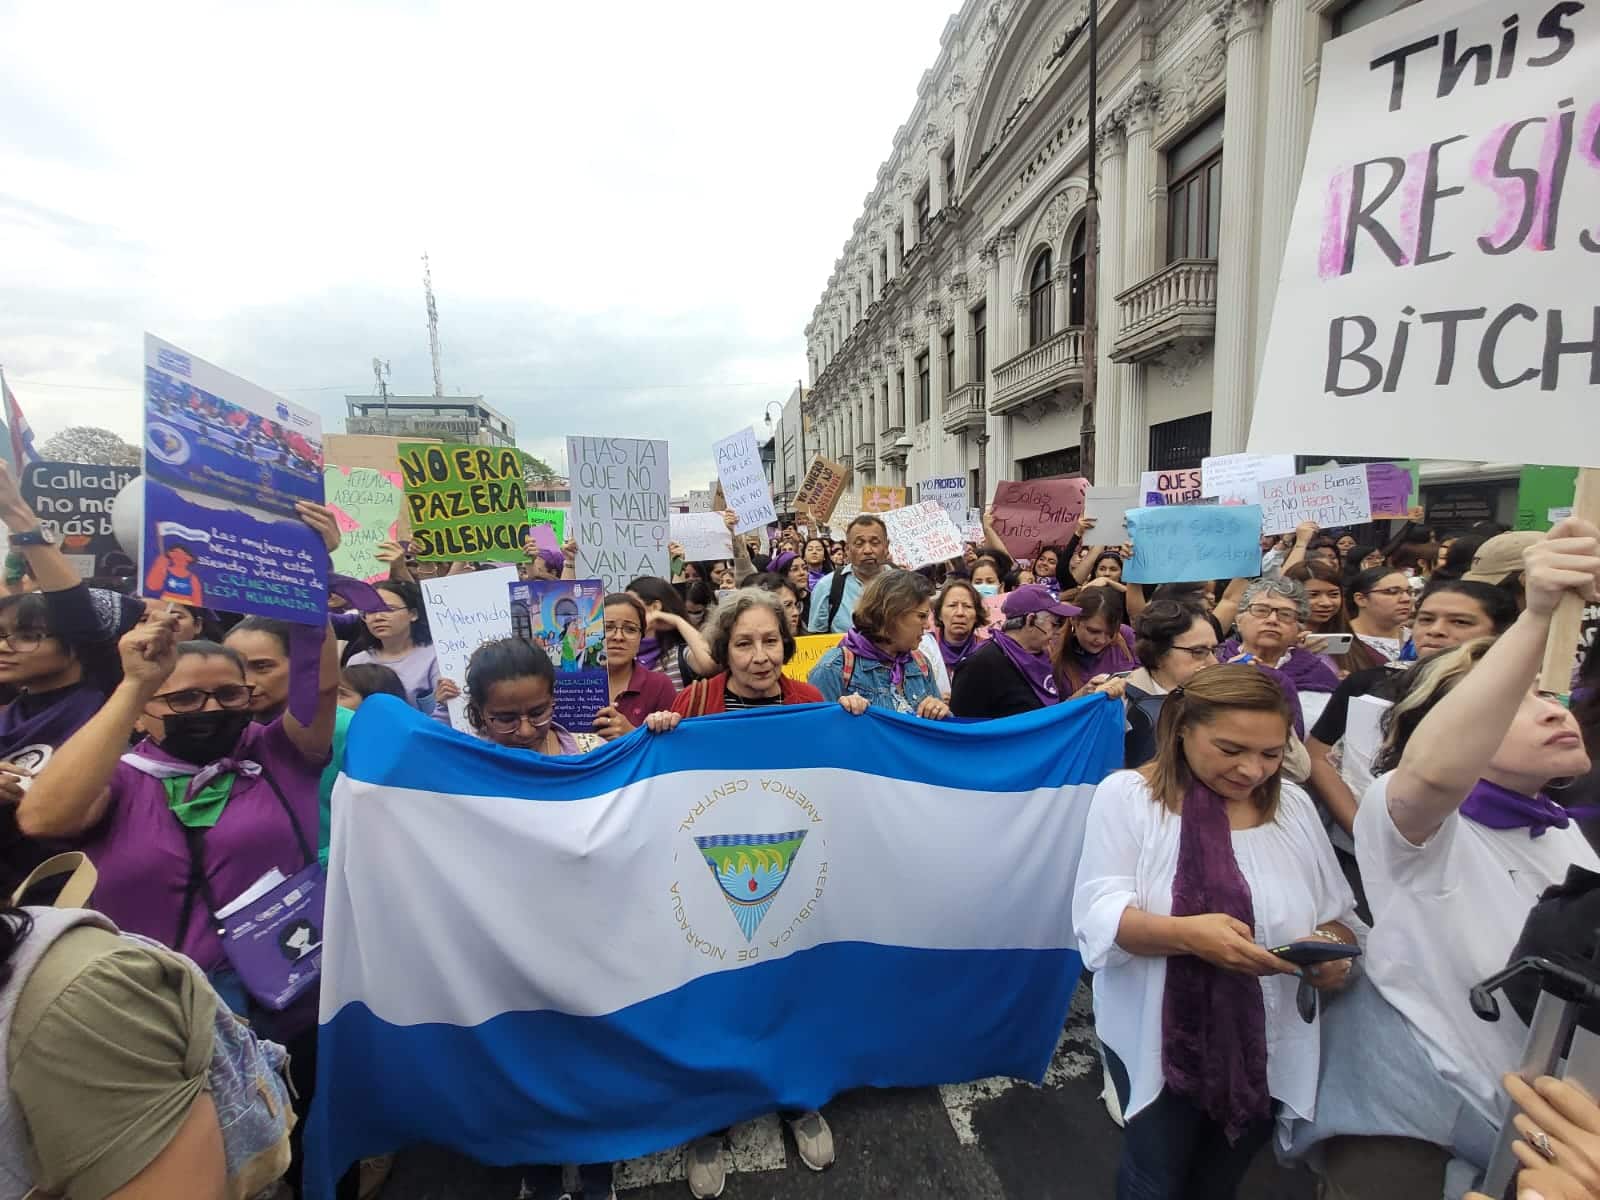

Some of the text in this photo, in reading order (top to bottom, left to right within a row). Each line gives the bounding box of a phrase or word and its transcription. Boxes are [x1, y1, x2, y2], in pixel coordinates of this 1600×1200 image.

[1369, 2, 1586, 113] This
[399, 449, 521, 487] NO ERA
[579, 462, 651, 491] QUE NO
[921, 477, 966, 490] YO PROTESTO
[1007, 484, 1053, 505] Solas
[1157, 473, 1187, 491] QUE
[1262, 484, 1283, 499] Las
[1324, 473, 1362, 490] Buenas
[37, 495, 73, 513] no
[408, 482, 526, 523] PAZ ERA
[578, 494, 601, 520] ME
[610, 492, 668, 521] MATEN
[1281, 498, 1298, 511] NO
[581, 522, 603, 547] NO
[615, 523, 649, 548] ME
[580, 550, 656, 575] VAN A
[425, 583, 446, 606] La
[678, 778, 823, 834] AMERICA CENTRAL
[669, 861, 828, 961] REPUBLICA DE NICARAGUA
